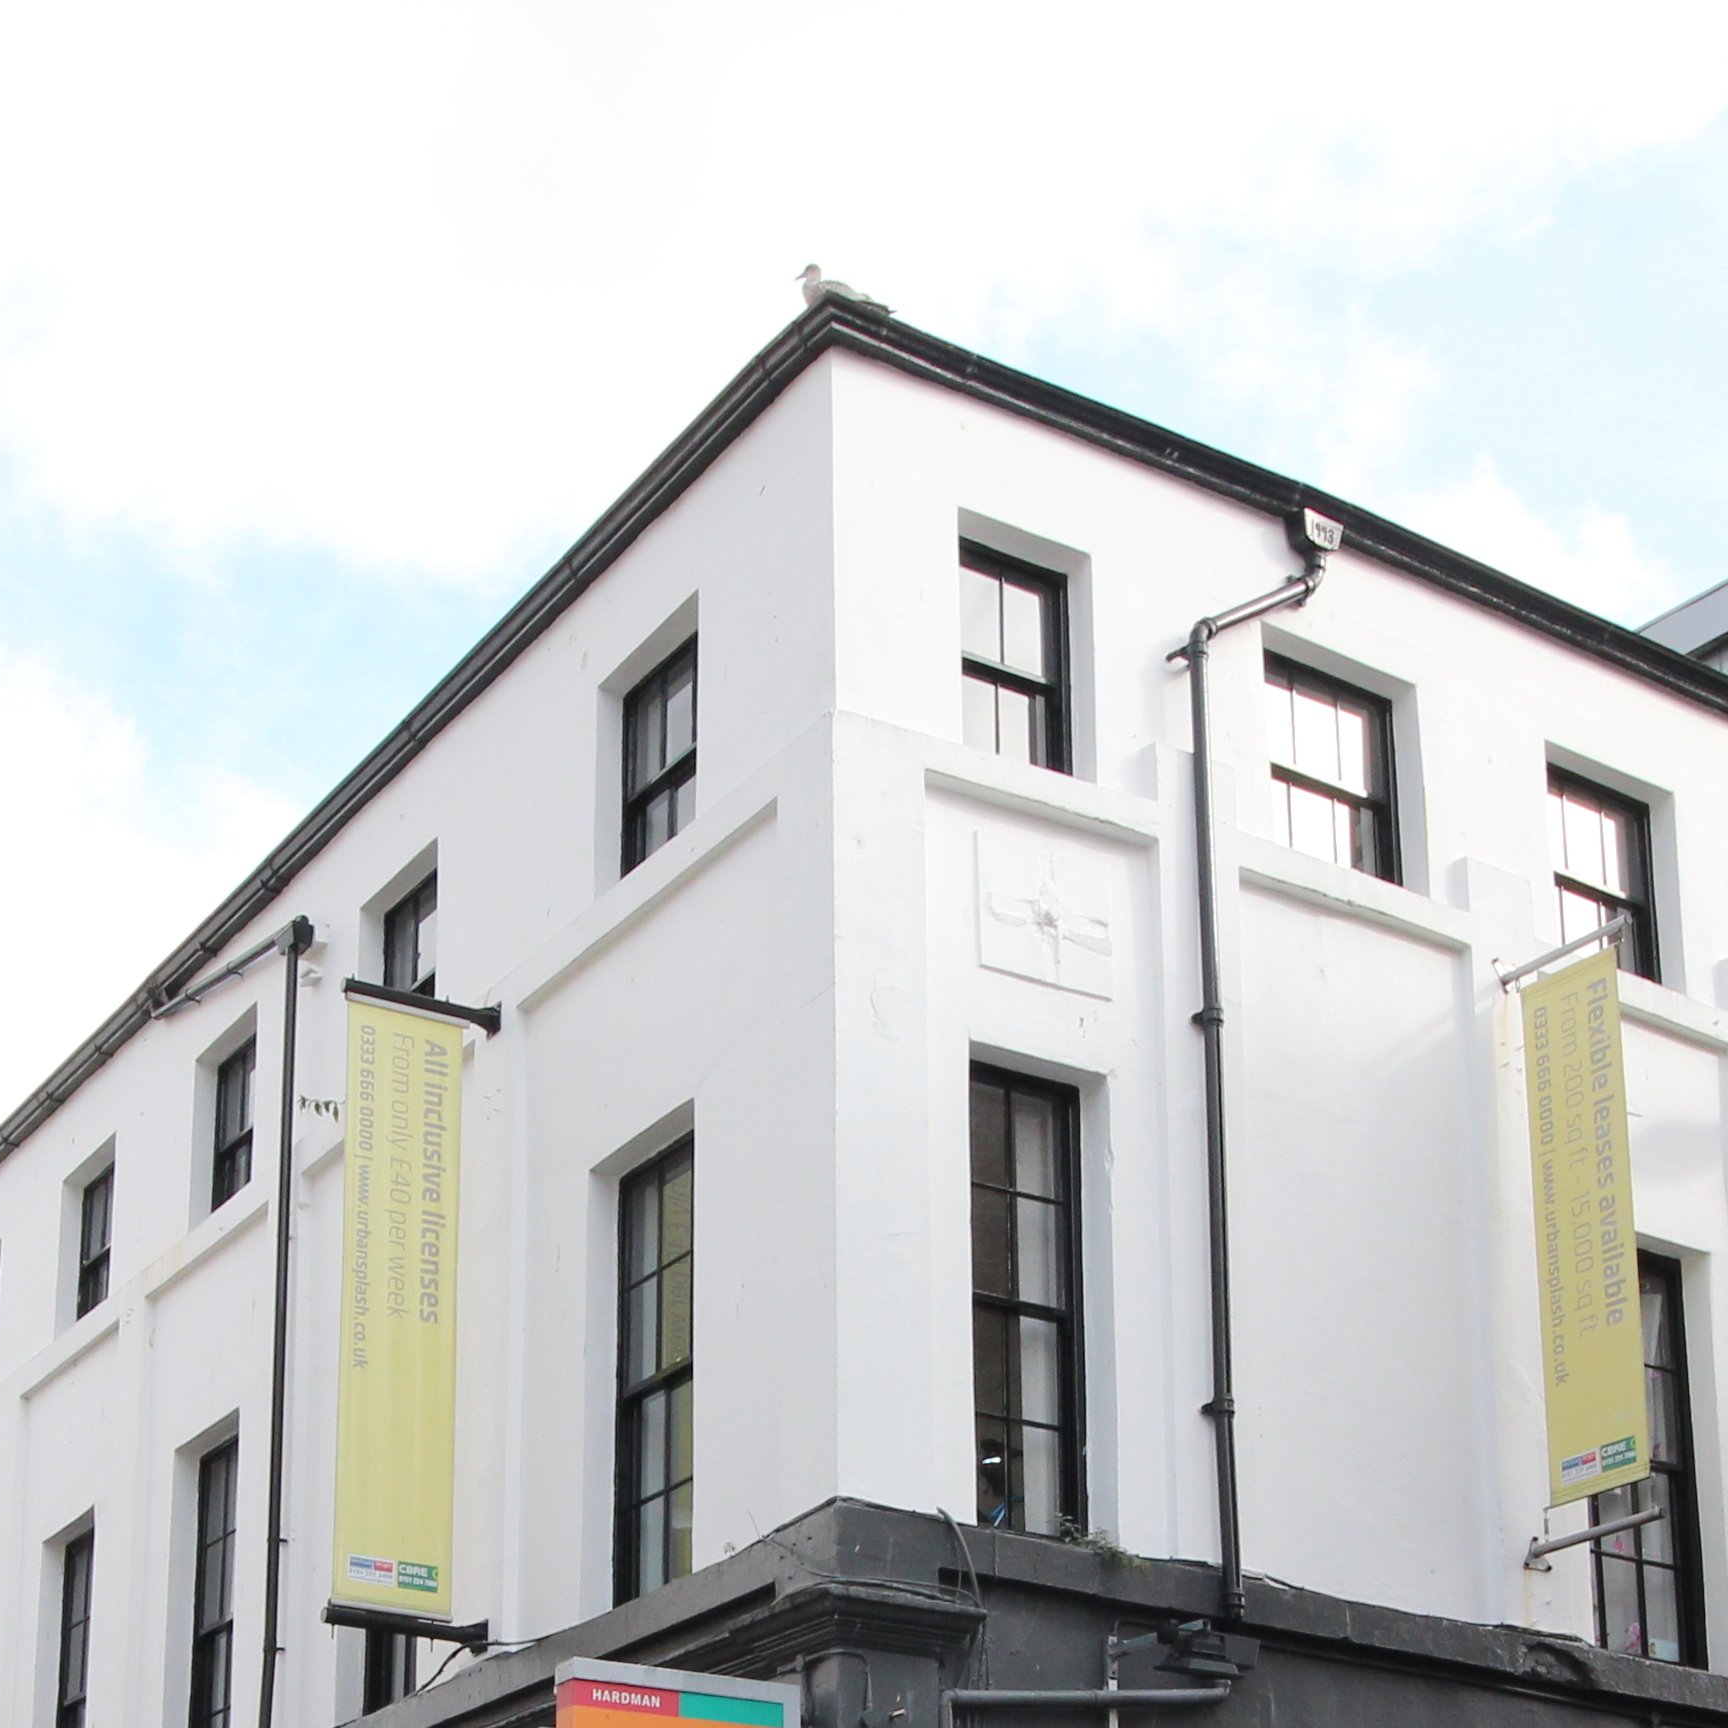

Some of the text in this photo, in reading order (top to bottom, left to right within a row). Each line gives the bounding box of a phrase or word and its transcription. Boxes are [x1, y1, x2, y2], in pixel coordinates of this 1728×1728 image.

[1534, 1007, 1551, 1051] 0333
[1560, 991, 1578, 1051] From
[360, 1025, 375, 1066] 0333
[359, 1069, 374, 1098] 666
[1537, 1057, 1551, 1091] 666
[1563, 1060, 1584, 1105] 200
[358, 1106, 374, 1152] 0000
[1539, 1097, 1554, 1145] 0000
[1562, 1113, 1582, 1148] sq
[1568, 1147, 1587, 1170] ft
[1587, 977, 1628, 1326] Flexible leases available
[384, 1031, 415, 1320] From only £40 per week
[419, 1038, 449, 1324] All inclusive licenses
[352, 1163, 372, 1370] www.urbansplash.co.uk
[1543, 1159, 1569, 1386] www.urbansplash.co.uk
[1575, 1279, 1593, 1314] sq
[1579, 1314, 1598, 1337] ft
[592, 1688, 661, 1708] HARDMAN
